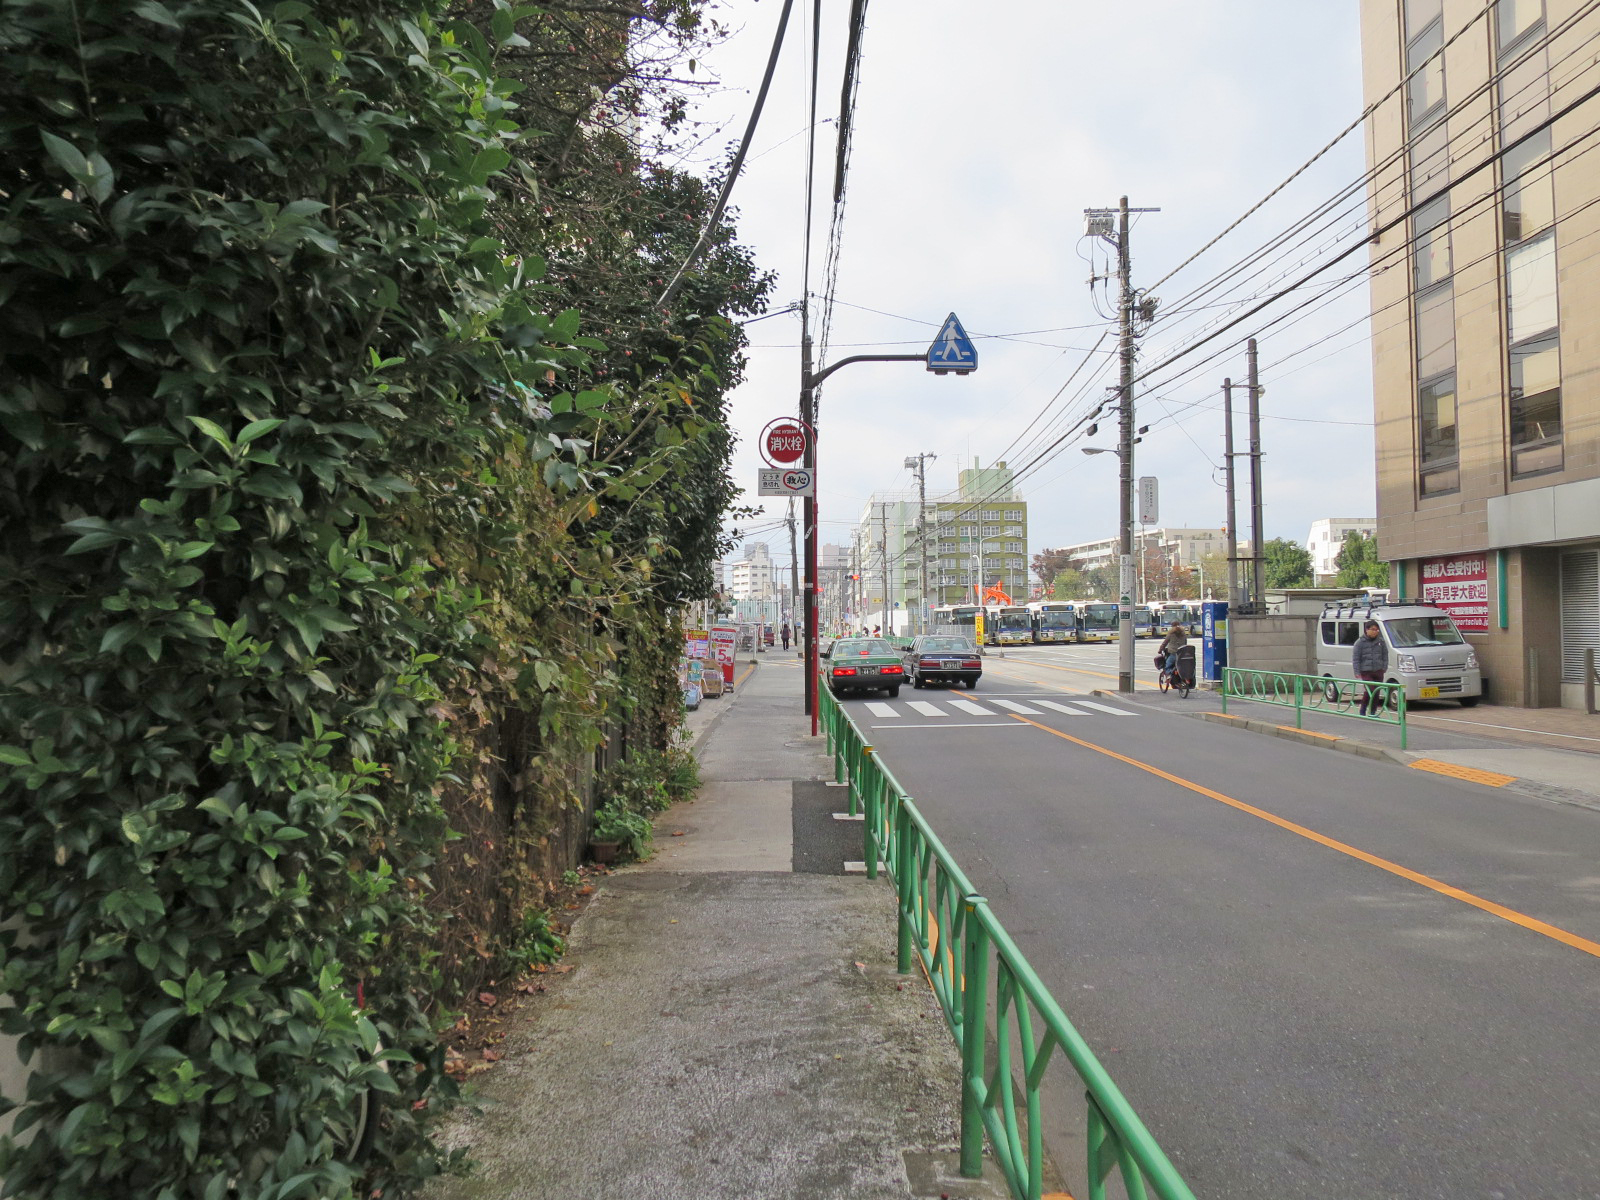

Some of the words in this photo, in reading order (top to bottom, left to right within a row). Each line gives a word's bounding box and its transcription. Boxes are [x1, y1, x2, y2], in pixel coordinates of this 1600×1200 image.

[770, 436, 802, 451] 消火栓
[1425, 584, 1487, 601] 施設見学大歓迎
